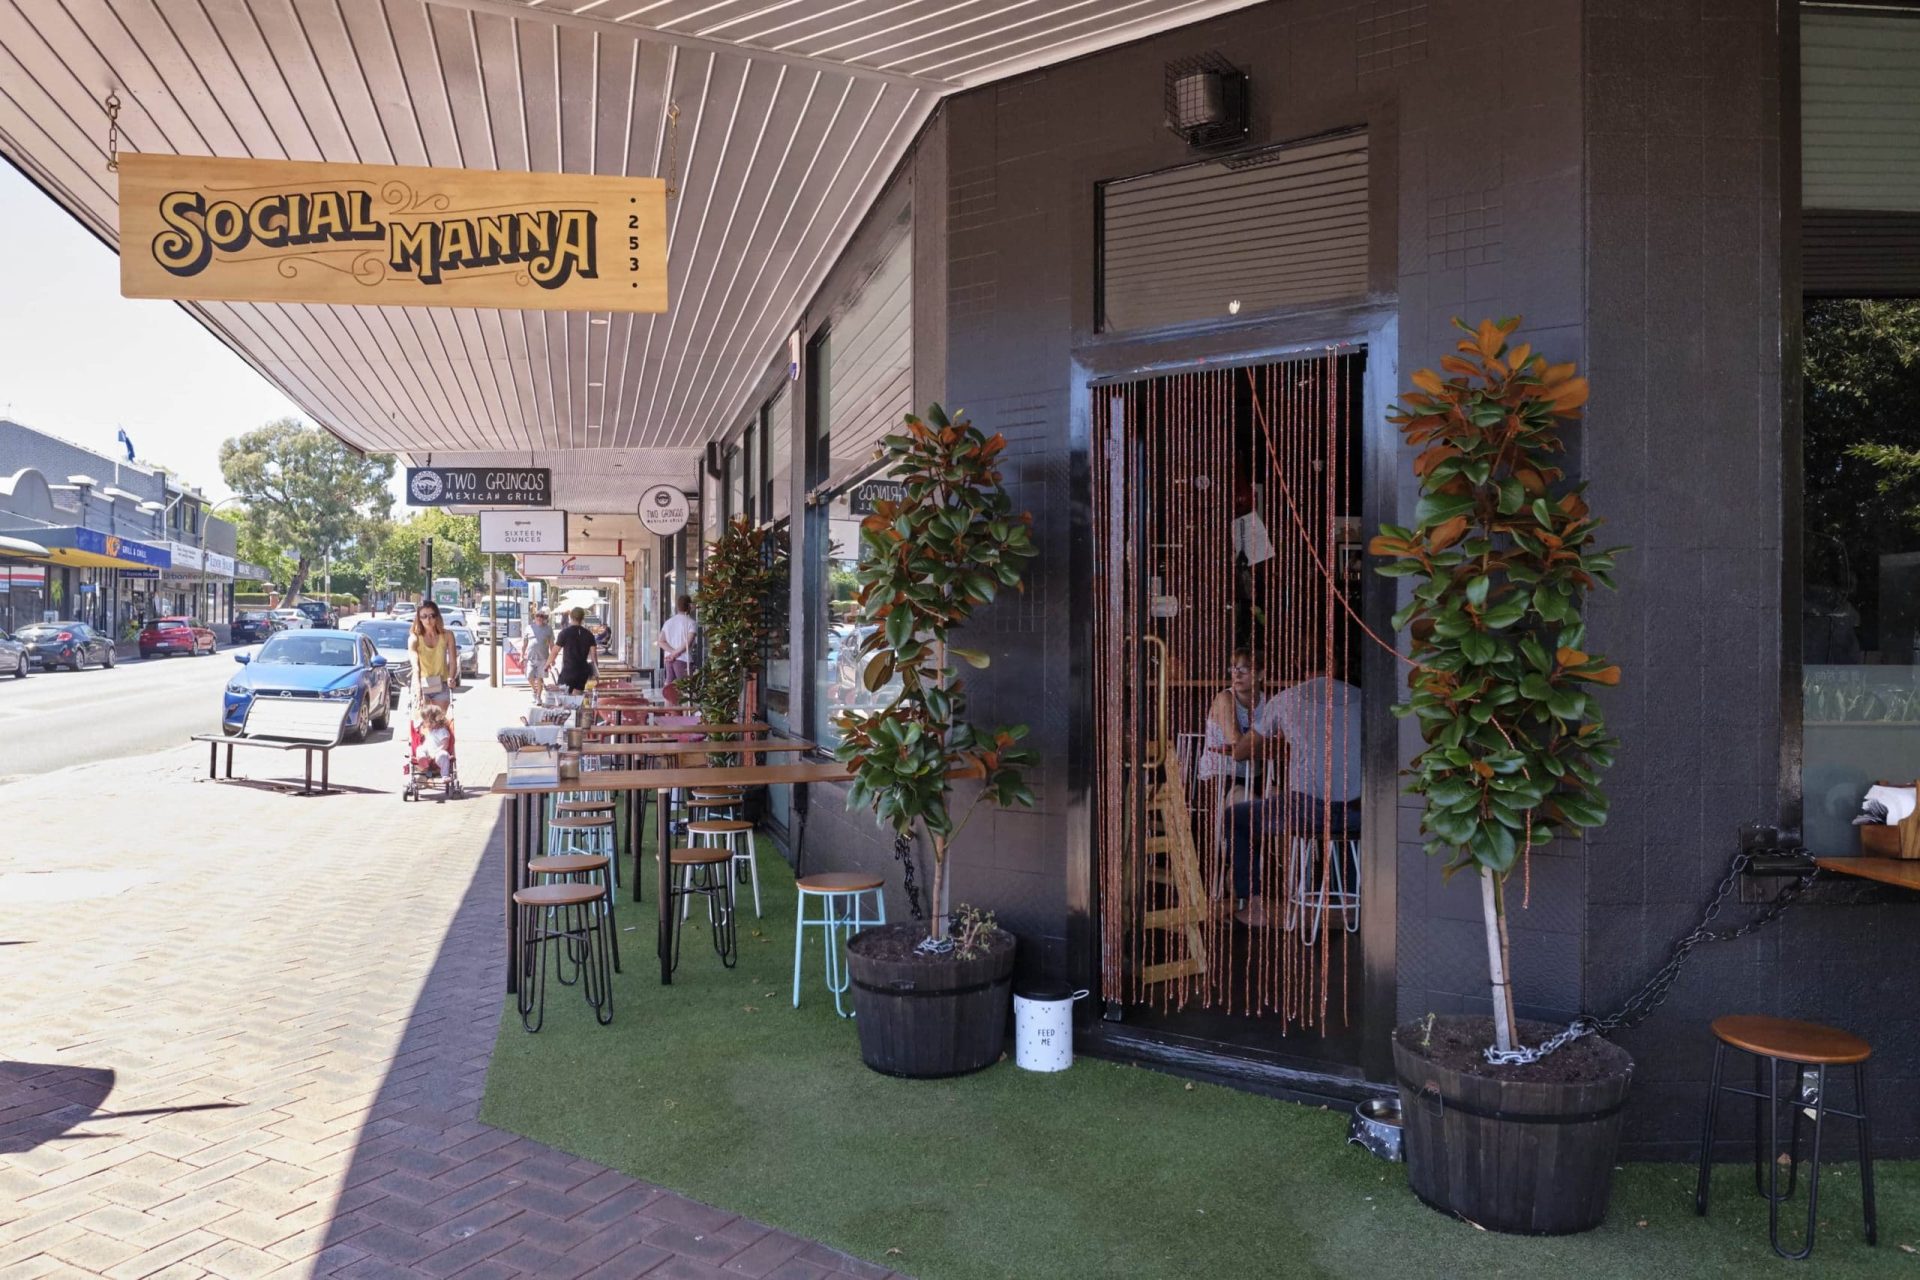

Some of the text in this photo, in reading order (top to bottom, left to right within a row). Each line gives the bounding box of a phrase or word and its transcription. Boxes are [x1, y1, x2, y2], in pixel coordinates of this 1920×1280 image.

[151, 190, 599, 290] SOCIAL MANNA
[445, 472, 544, 491] TWO GRINGOS
[445, 492, 544, 501] MEXICAN GRILL
[647, 510, 659, 518] TWO
[1037, 1029, 1055, 1037] FEED
[1040, 1038, 1051, 1046] ME
